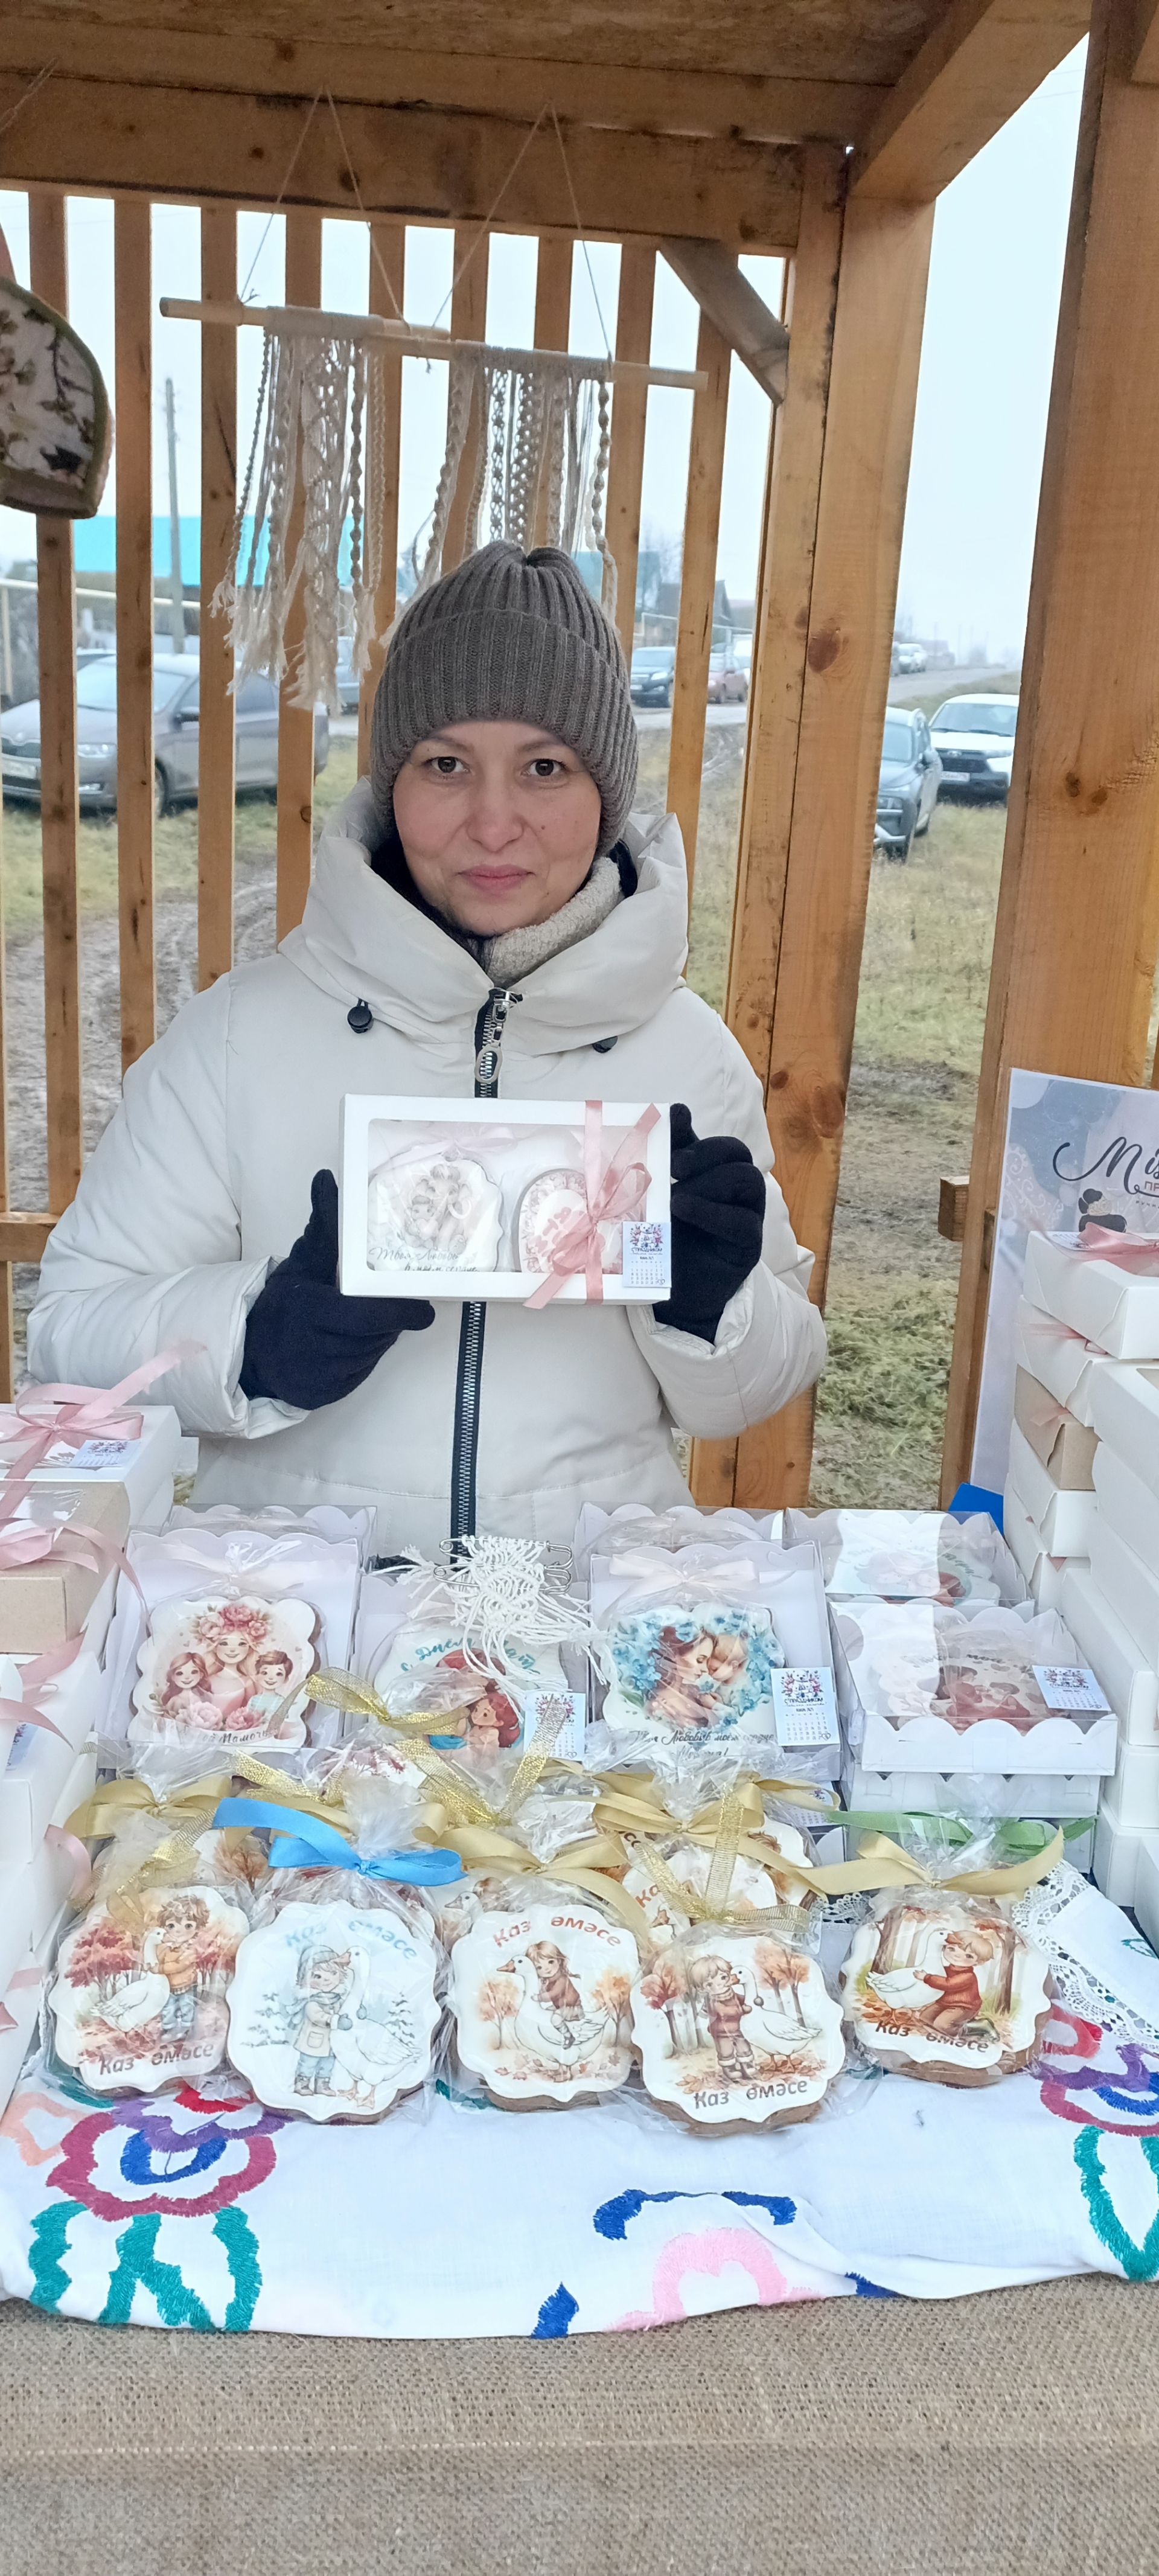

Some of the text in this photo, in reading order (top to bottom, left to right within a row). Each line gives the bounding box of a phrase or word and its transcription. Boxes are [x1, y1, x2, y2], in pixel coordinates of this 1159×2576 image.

[493, 1920, 532, 1948] Каз
[875, 2020, 910, 2037] Каз
[100, 2054, 134, 2075] Каз
[694, 2091, 729, 2109] Каз
